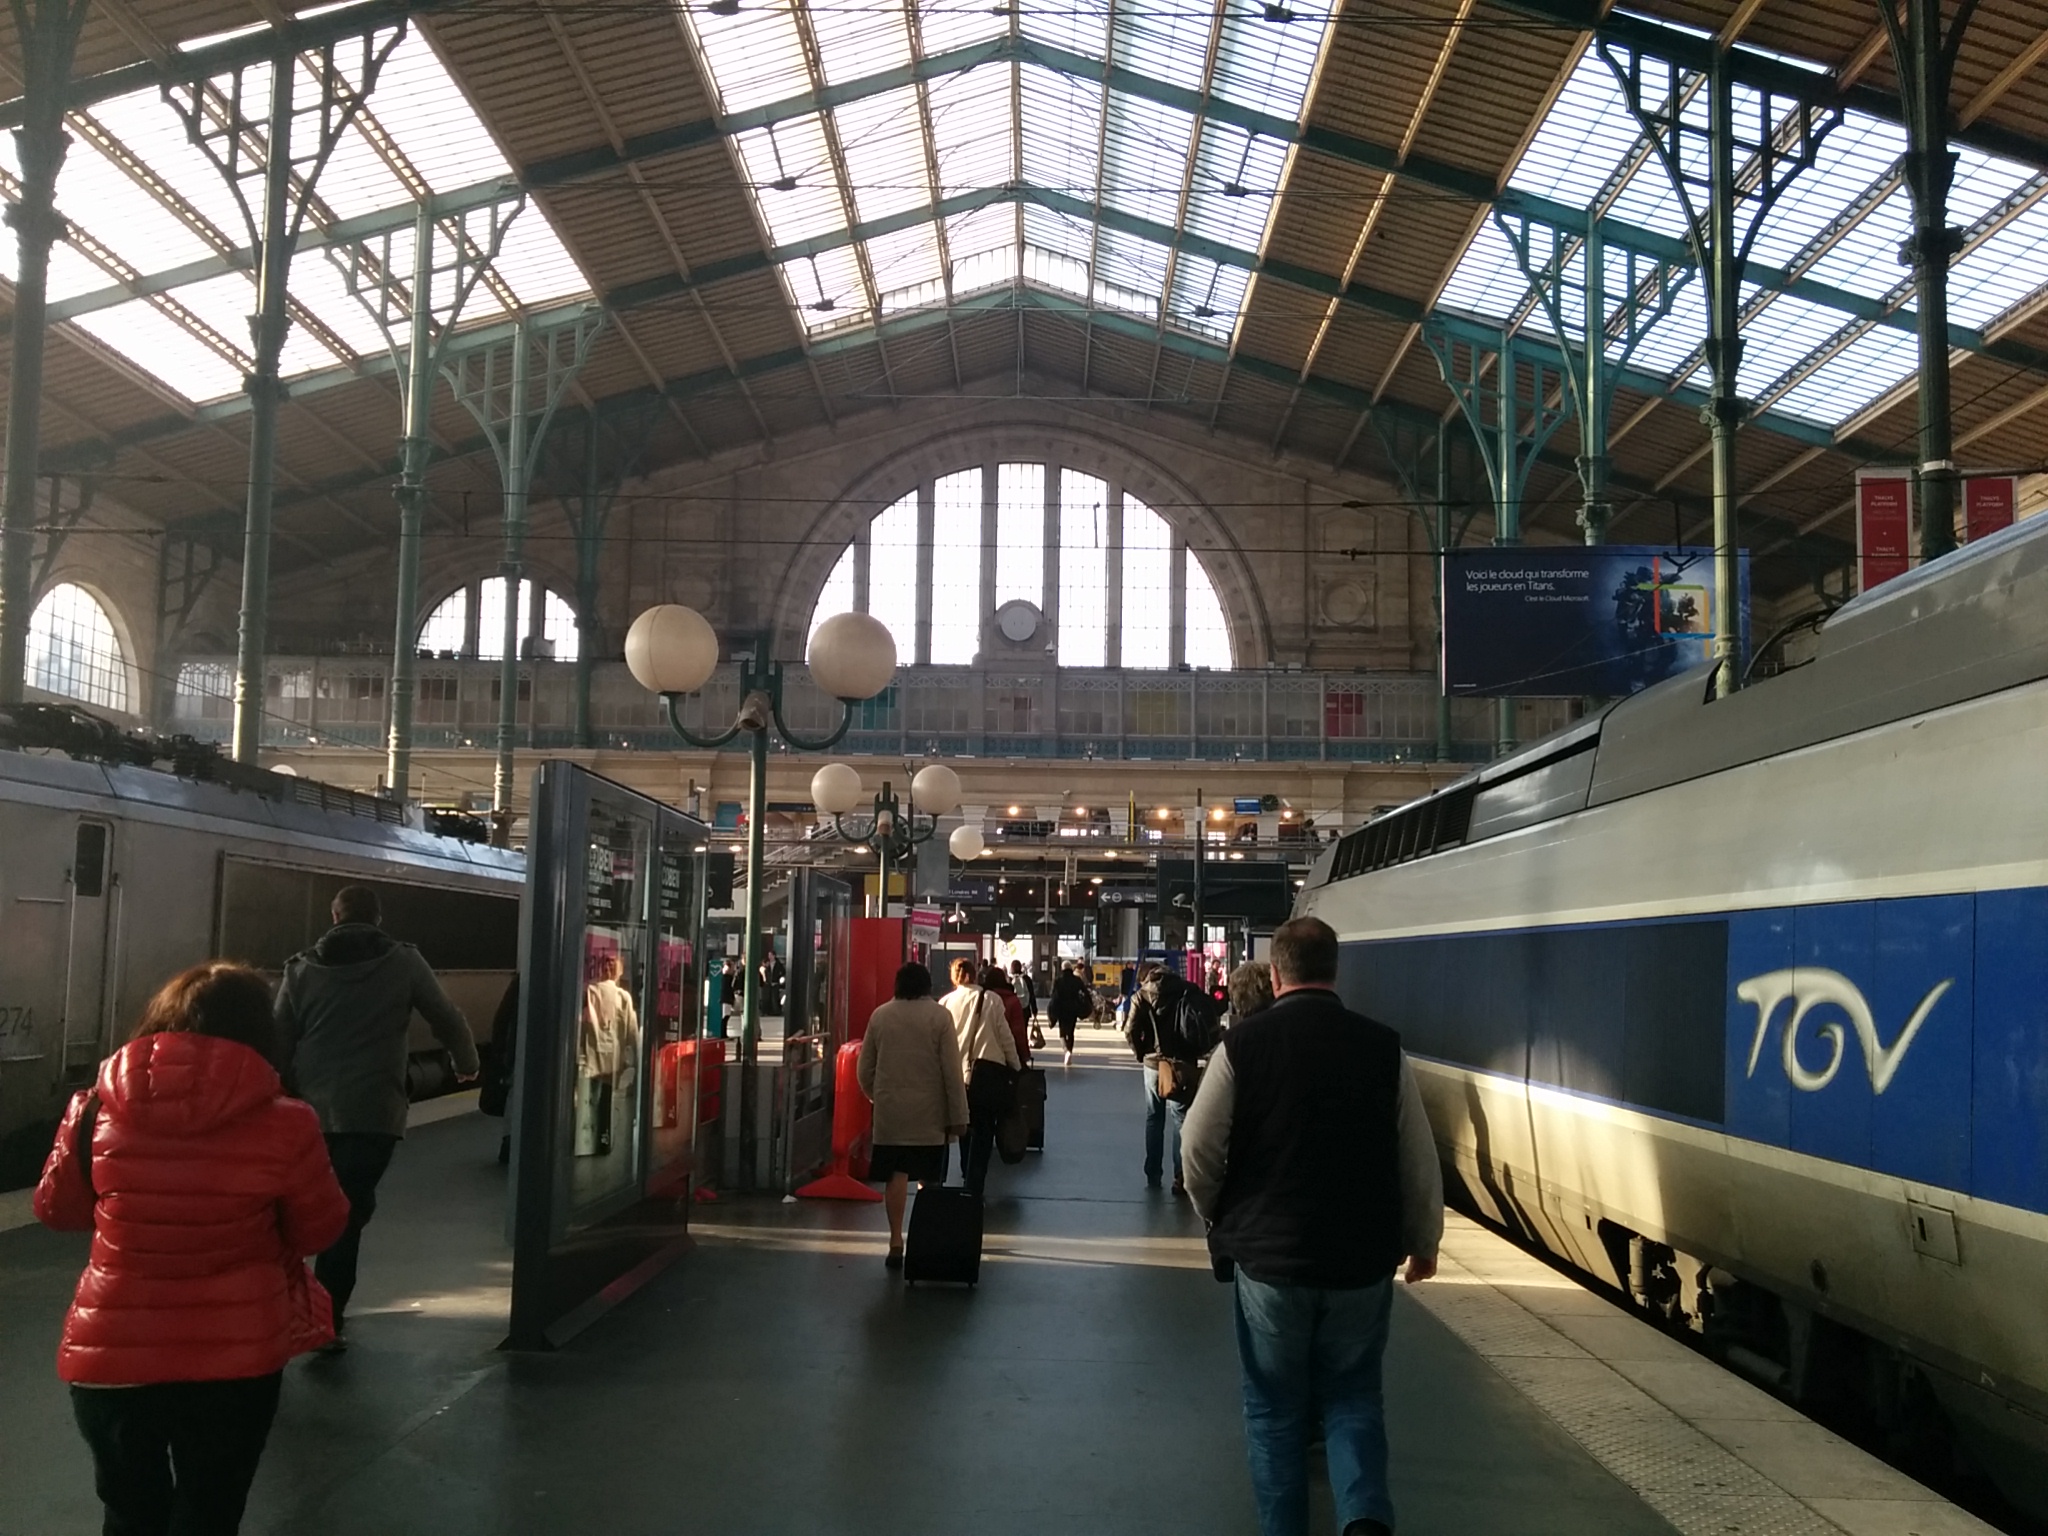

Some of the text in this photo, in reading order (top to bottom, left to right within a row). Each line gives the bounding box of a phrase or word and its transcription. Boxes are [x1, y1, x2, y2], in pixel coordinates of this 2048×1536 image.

[1465, 568, 1590, 581] Voici le cloud qui transforme
[1466, 580, 1556, 594] les joueurs en Titans.
[1736, 966, 1956, 1096] TGV
